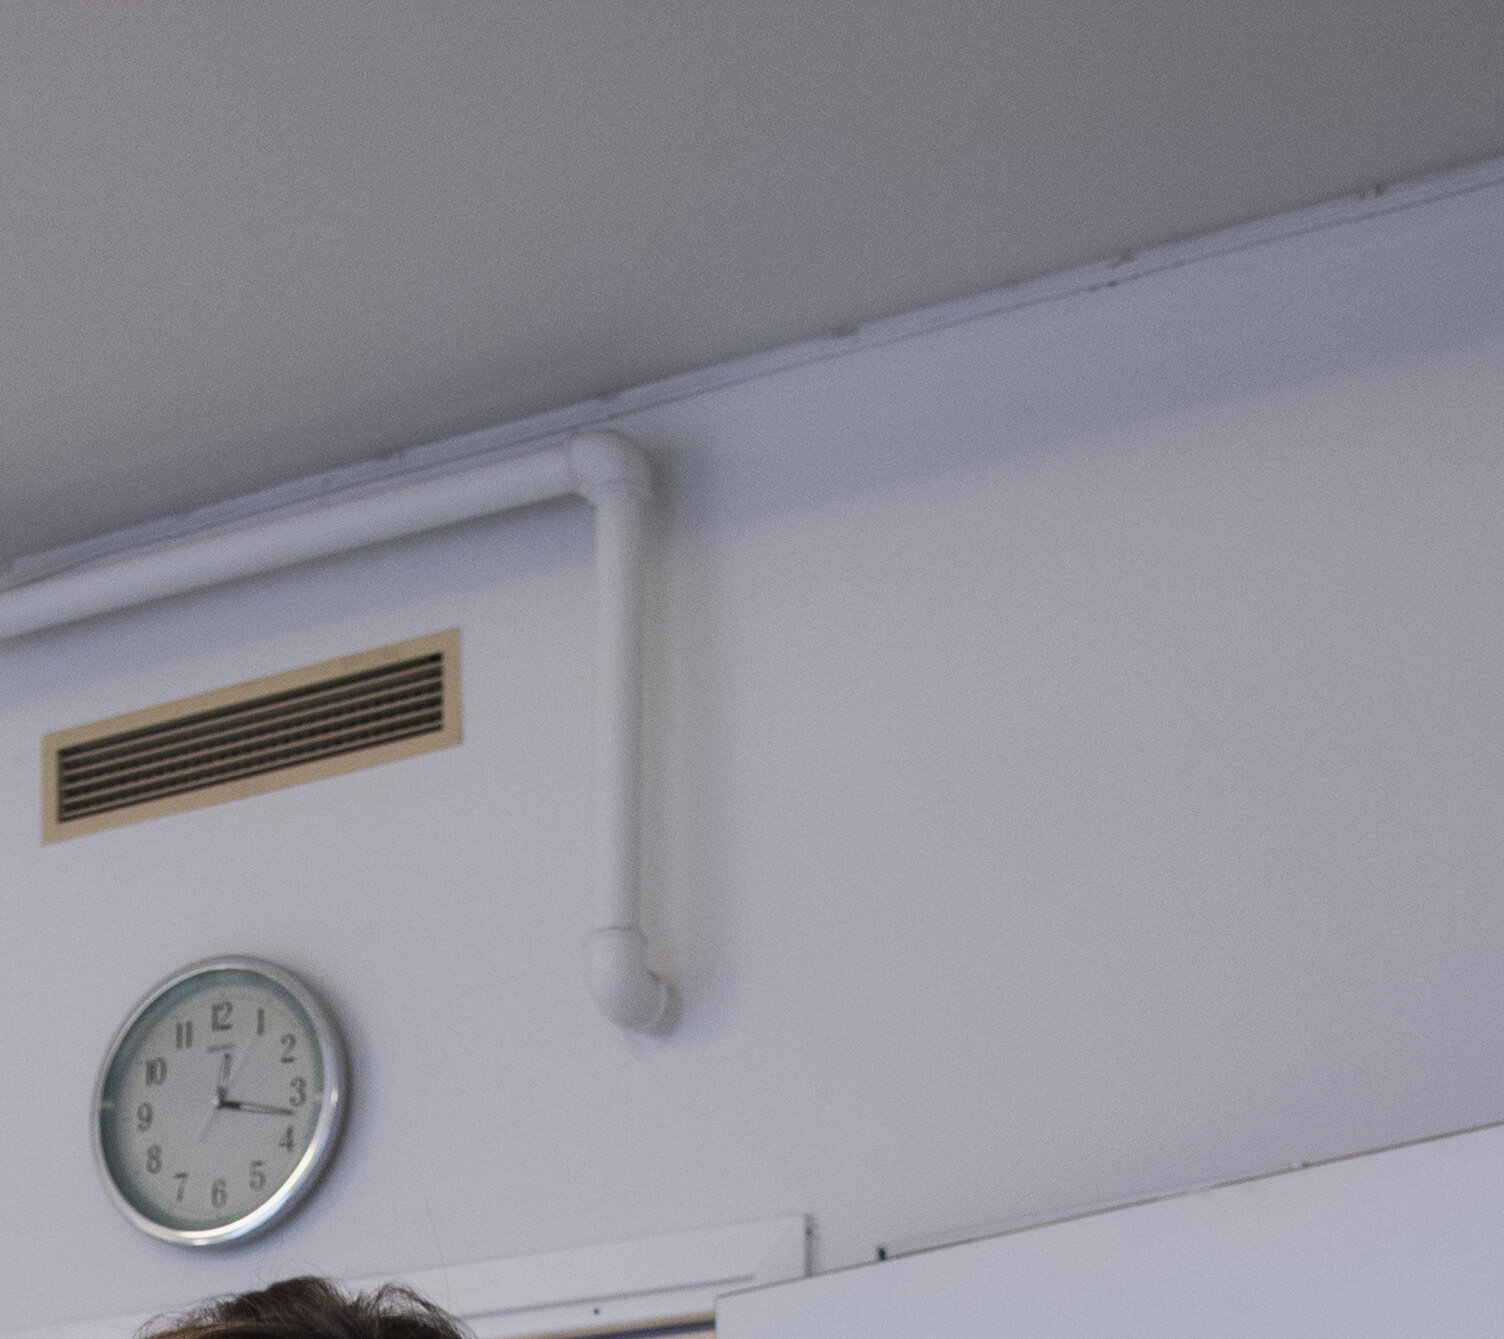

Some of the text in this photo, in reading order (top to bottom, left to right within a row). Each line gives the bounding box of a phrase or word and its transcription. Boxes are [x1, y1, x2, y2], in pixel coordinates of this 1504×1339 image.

[211, 1001, 233, 1031] 12
[256, 1009, 265, 1036] 1
[176, 1021, 193, 1050] 11
[280, 1034, 297, 1063] 2
[145, 1056, 168, 1087] 10
[289, 1078, 306, 1107] 3
[136, 1102, 153, 1131] 9
[278, 1127, 294, 1153] 4
[146, 1145, 163, 1174] 8
[173, 1172, 187, 1202] 7
[249, 1160, 267, 1191] 5
[210, 1179, 227, 1208] 6
